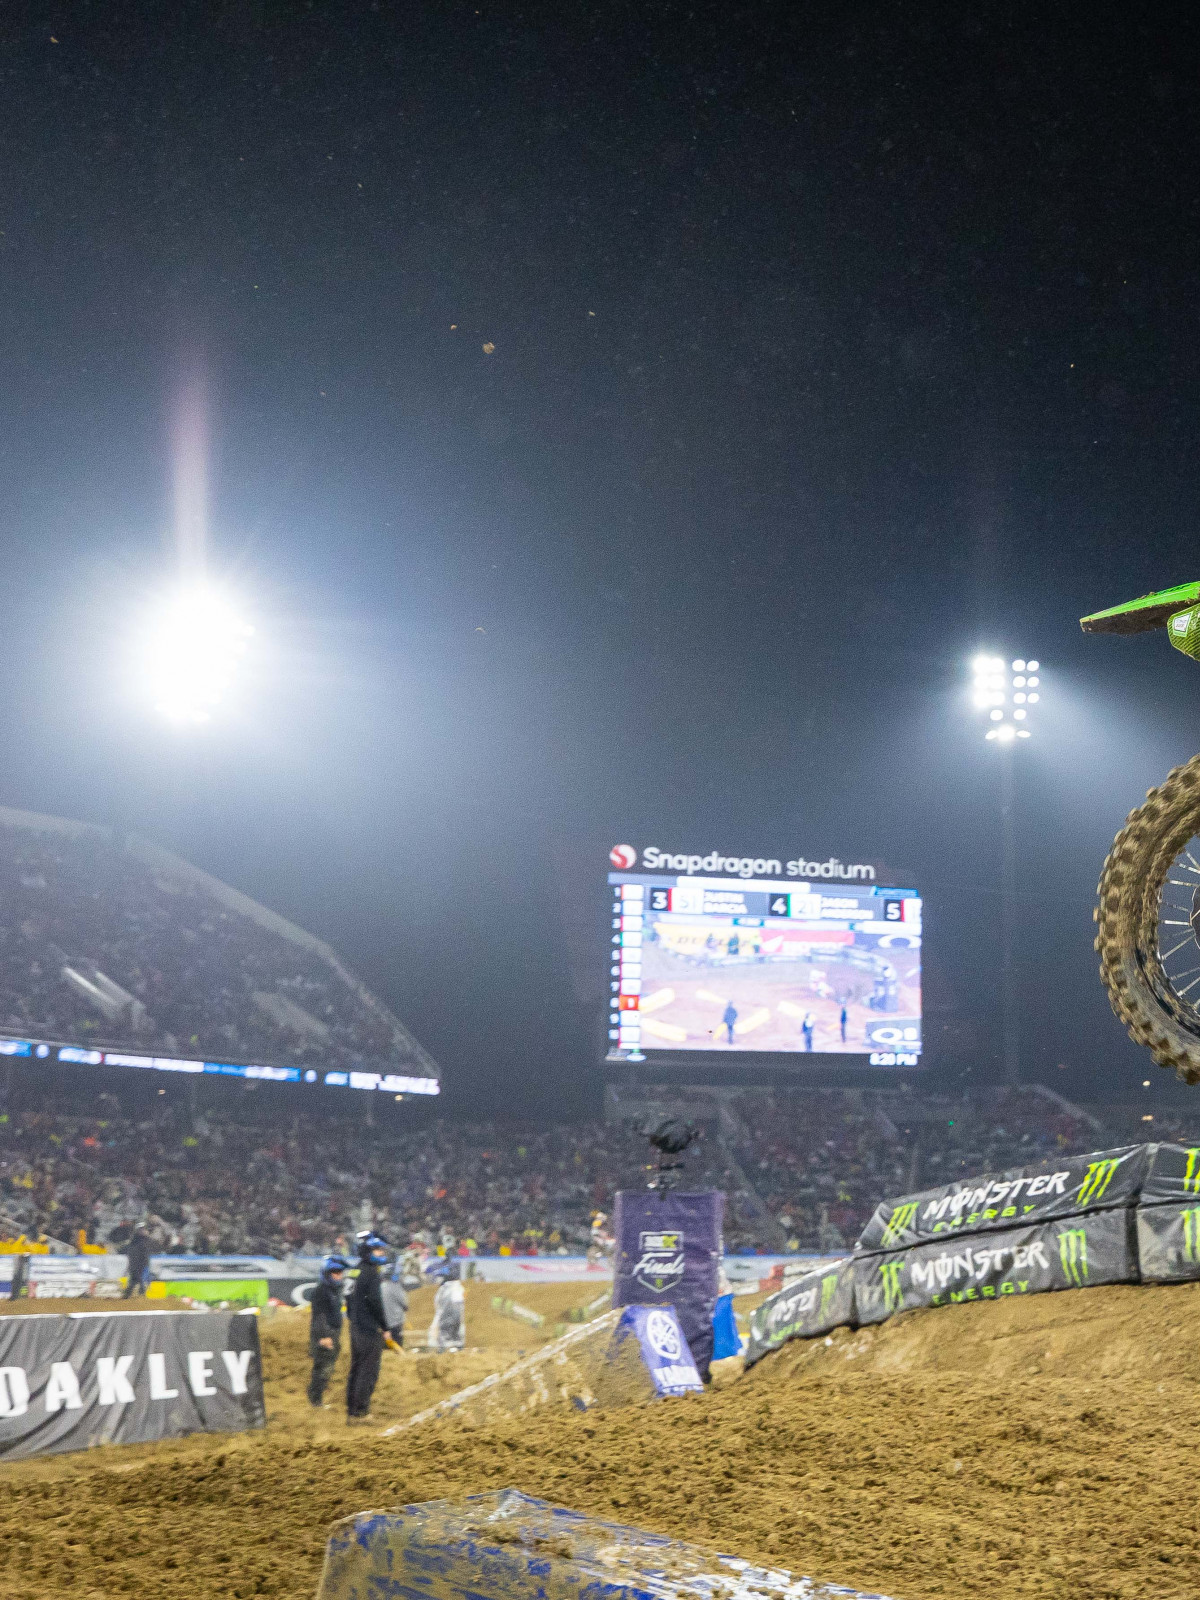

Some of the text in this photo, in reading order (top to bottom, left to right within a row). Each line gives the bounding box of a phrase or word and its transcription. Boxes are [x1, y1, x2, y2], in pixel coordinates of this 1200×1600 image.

[642, 846, 876, 880] Snapdragon stadium
[653, 891, 668, 910] 3
[772, 898, 786, 915] 4
[922, 1171, 1070, 1220] MONSTER
[910, 1240, 1049, 1290] MONSTER
